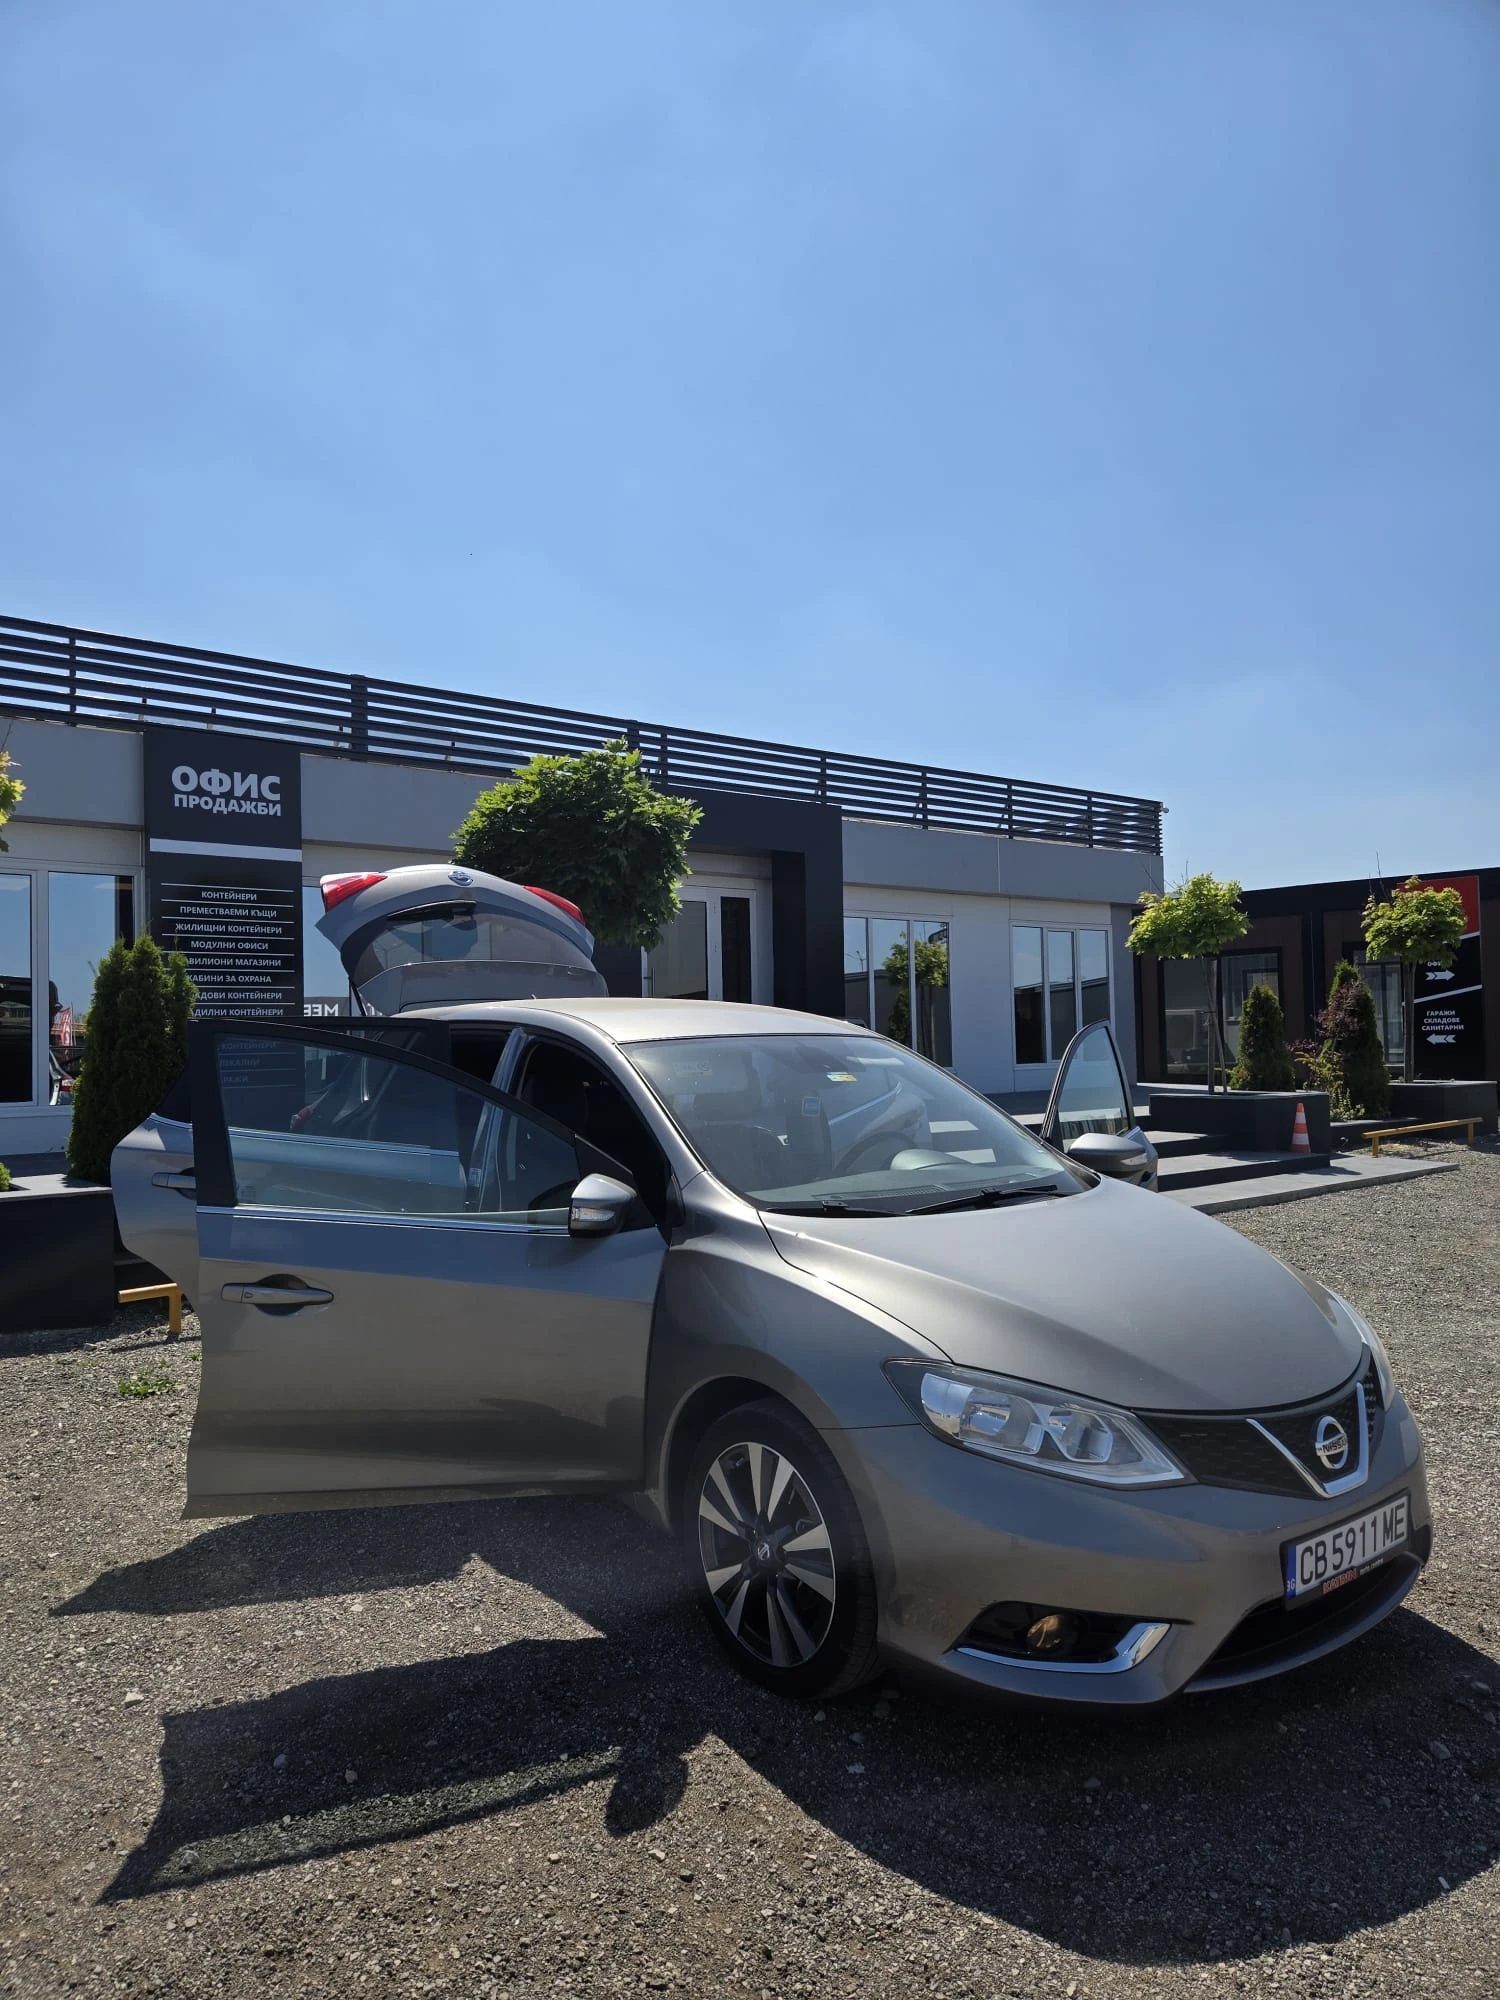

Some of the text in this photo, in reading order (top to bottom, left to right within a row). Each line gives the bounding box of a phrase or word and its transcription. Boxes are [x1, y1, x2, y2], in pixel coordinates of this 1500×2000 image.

[171, 765, 281, 801] ОФИС
[174, 793, 282, 817] ПРОДАЖБИ
[201, 890, 257, 901] КОНТЕЙНЕРИ
[180, 906, 277, 919] ПРЕМЕСТВАЕМИ КЪЩИ
[175, 923, 282, 934] ЖИЛИЩНИ КОНТЕЙНЕРИ
[190, 940, 269, 950] МОДУЛНИ ОФИСИ
[188, 957, 282, 967] ВИЛИОНИ МАГАЗИНИ
[238, 975, 272, 983] ОХРАНА
[227, 990, 282, 1000] КОНТЕЙНЕРИ
[229, 1007, 284, 1016] КОНТЕЙНЕРИ
